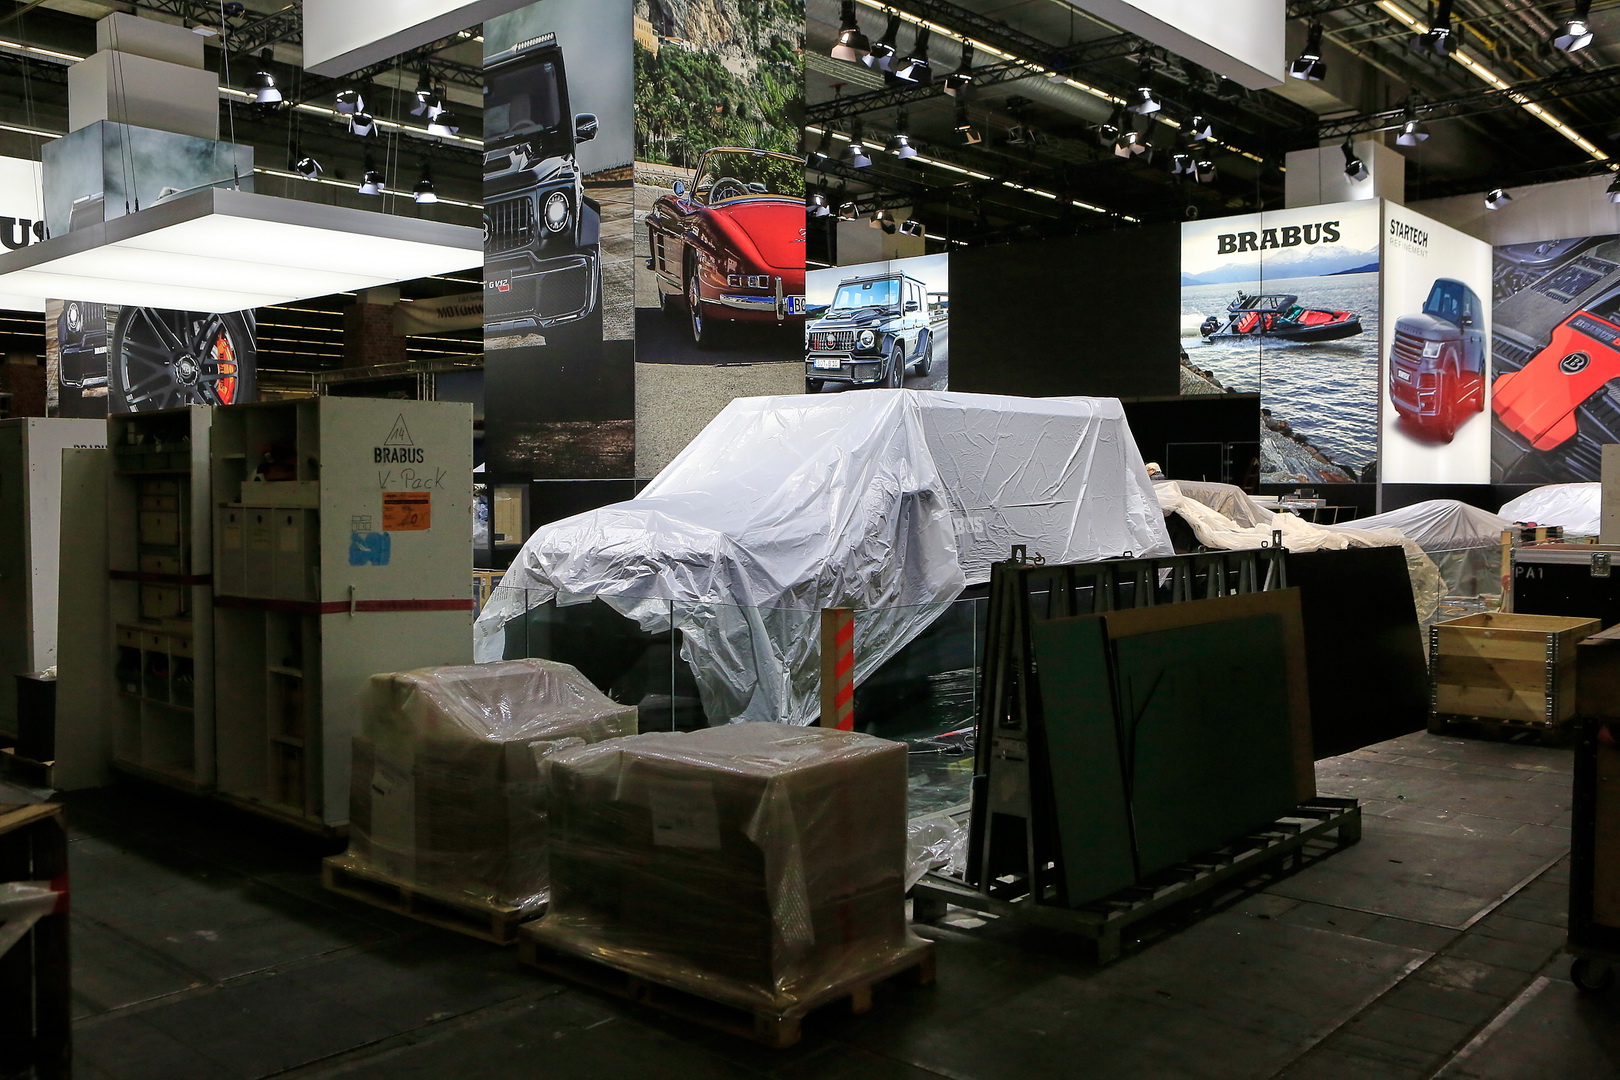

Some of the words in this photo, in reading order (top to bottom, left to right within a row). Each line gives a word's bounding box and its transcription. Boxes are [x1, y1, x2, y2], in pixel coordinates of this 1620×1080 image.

[1217, 221, 1341, 255] BRABUS
[1390, 219, 1429, 247] STARTECH
[1390, 237, 1428, 258] REFINEMENT
[374, 447, 424, 463] BRABUS
